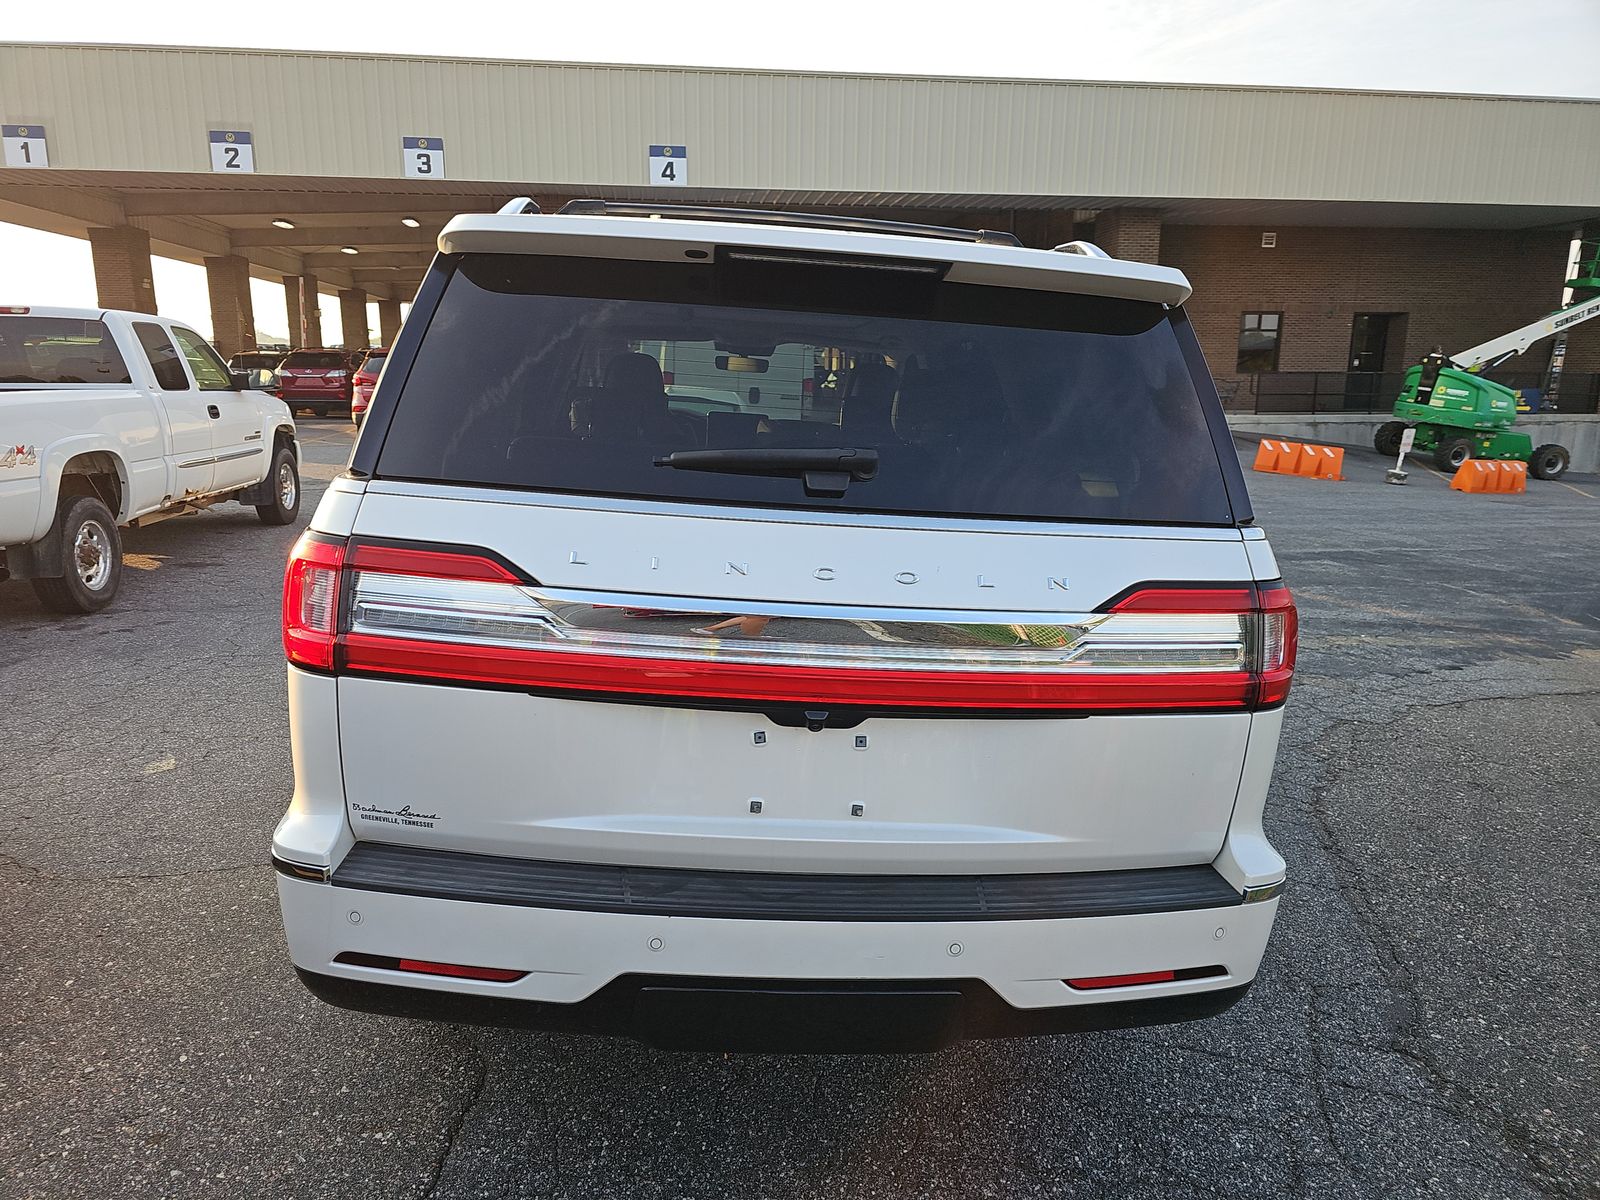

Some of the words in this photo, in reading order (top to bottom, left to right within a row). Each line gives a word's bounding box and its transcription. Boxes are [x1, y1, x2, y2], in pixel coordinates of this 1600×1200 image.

[20, 141, 31, 163] 1
[224, 147, 241, 169] 2
[416, 153, 432, 174] 3
[661, 161, 676, 181] 4
[1554, 310, 1586, 329] SUNBELT
[568, 550, 1070, 592] LINCOLN
[360, 813, 400, 825] GREENEVILLE,
[401, 818, 434, 829] TENNESSEE
